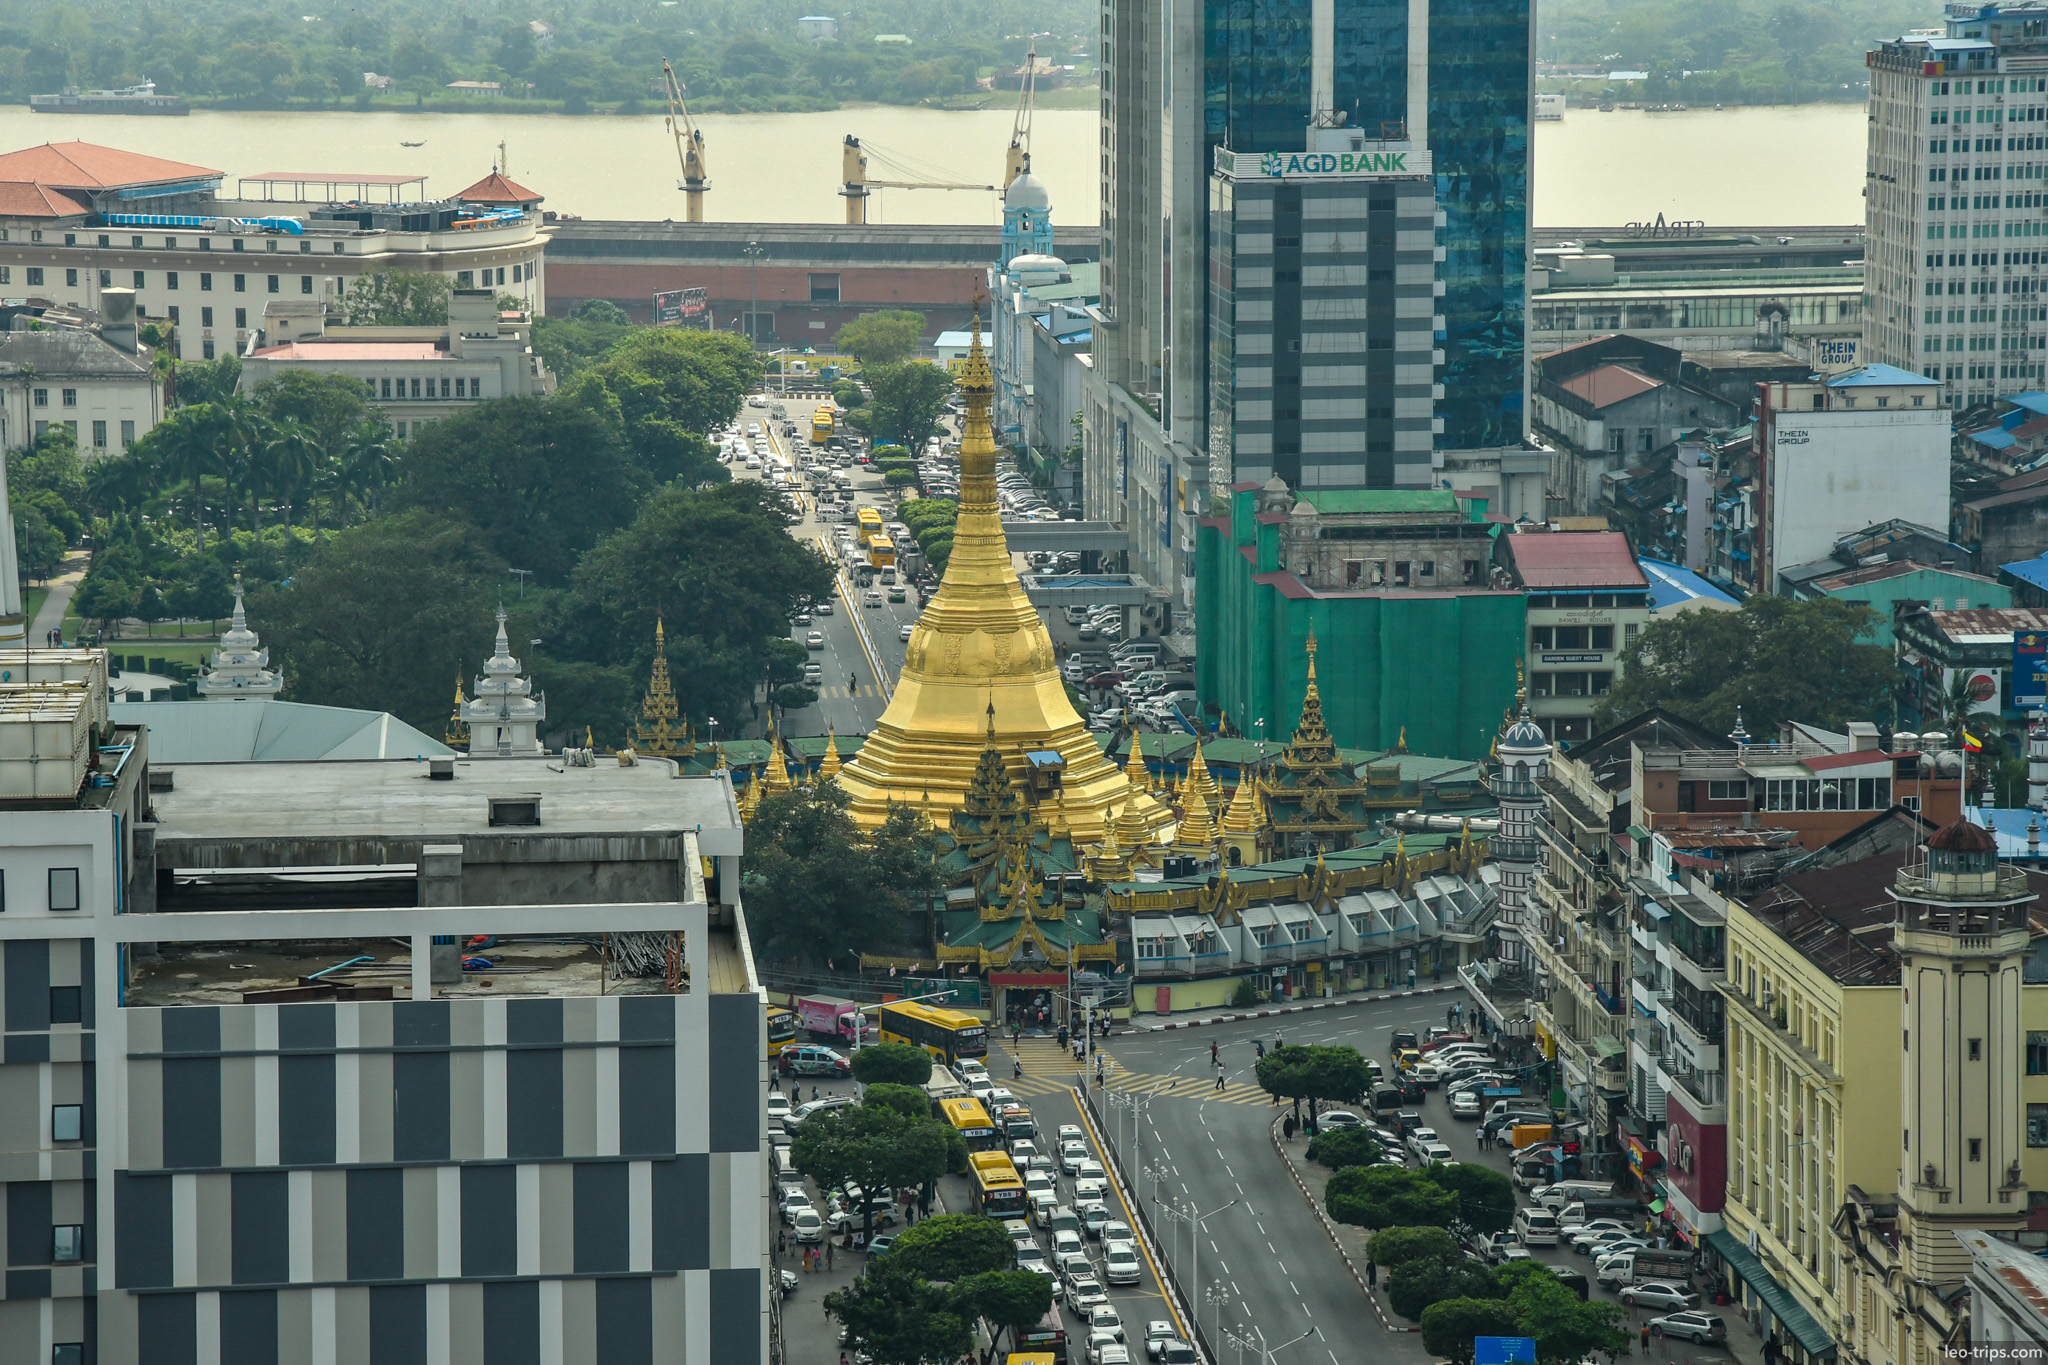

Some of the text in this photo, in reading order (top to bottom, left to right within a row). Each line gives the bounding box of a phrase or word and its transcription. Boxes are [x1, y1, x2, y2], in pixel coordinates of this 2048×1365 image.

[1286, 152, 1407, 173] AGD BANK
[1821, 342, 1856, 353] THEIN
[1821, 354, 1854, 364] GROUP
